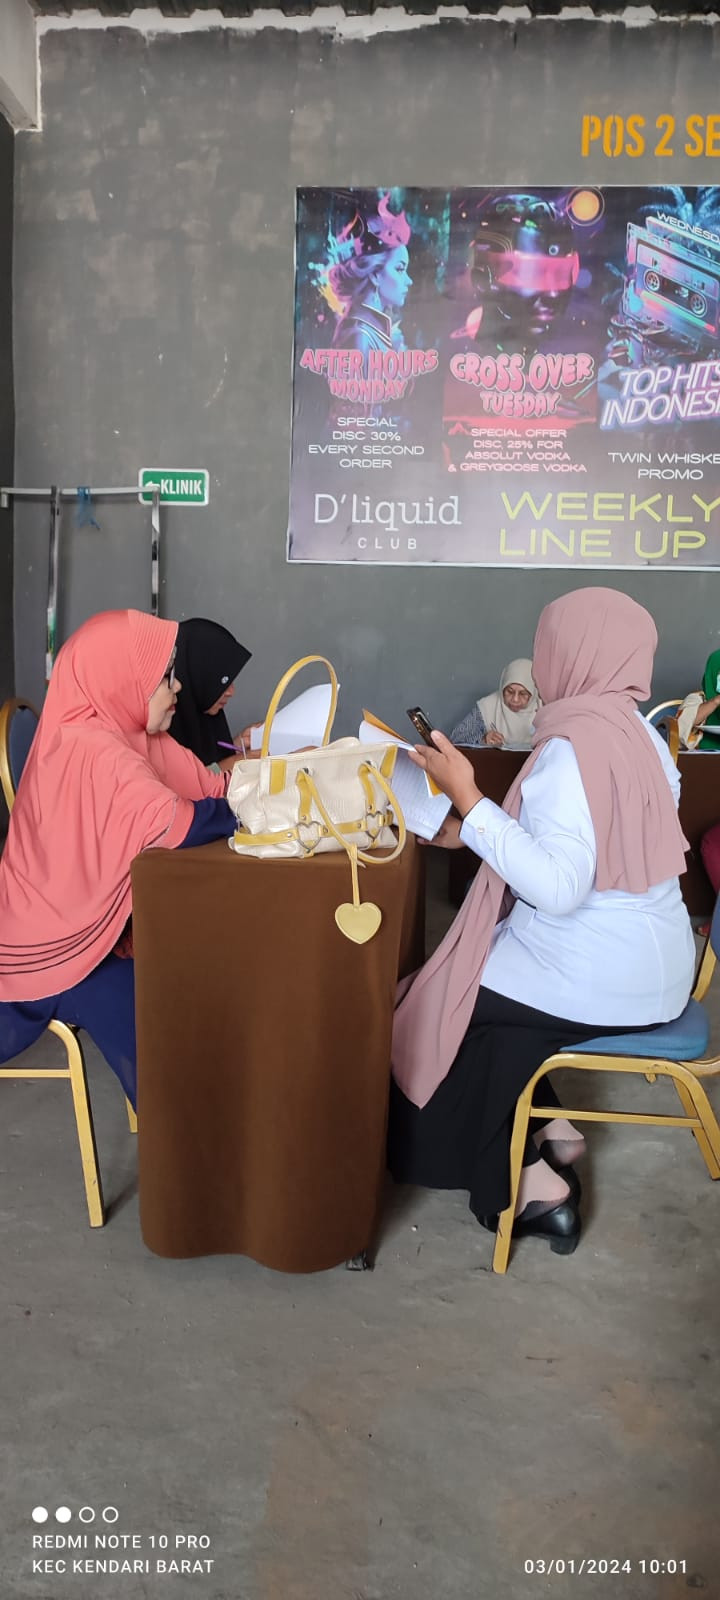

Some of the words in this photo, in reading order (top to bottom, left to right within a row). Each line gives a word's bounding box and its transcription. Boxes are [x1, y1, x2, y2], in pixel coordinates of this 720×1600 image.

[581, 114, 645, 157] POS
[654, 114, 675, 156] 2
[685, 114, 720, 157] SE
[656, 210, 720, 245] WEDNESD
[300, 349, 363, 380] AFTER
[368, 349, 438, 381] HOURS
[450, 353, 526, 393] CROSS
[529, 353, 594, 393] OVER
[620, 367, 673, 397] TOP
[328, 379, 408, 403] MONDAY
[480, 391, 562, 418] TUESDAY
[337, 417, 397, 427] SPECIAL
[332, 431, 366, 441] DISC
[370, 431, 401, 441] 30%
[471, 428, 522, 437] SPECIAL
[525, 429, 567, 438] OFFER
[308, 445, 358, 454] EVERY
[362, 445, 425, 455] SECOND
[507, 440, 533, 449] 25%
[537, 440, 563, 449] FOR
[465, 451, 523, 460] ABSOLUT
[526, 452, 571, 461] VODKA
[607, 452, 652, 463] TWIN
[657, 453, 720, 465] WHISKE
[339, 458, 393, 469] ORDER
[447, 463, 457, 472] &
[460, 462, 540, 472] GREYGOOSE
[542, 463, 588, 473] VODKA
[637, 469, 704, 480] PROMO
[160, 479, 202, 495] KLINIK
[500, 491, 720, 523] WEEKLY
[357, 537, 417, 550] CLUB
[500, 528, 612, 558] LINE
[634, 530, 706, 559] UP
